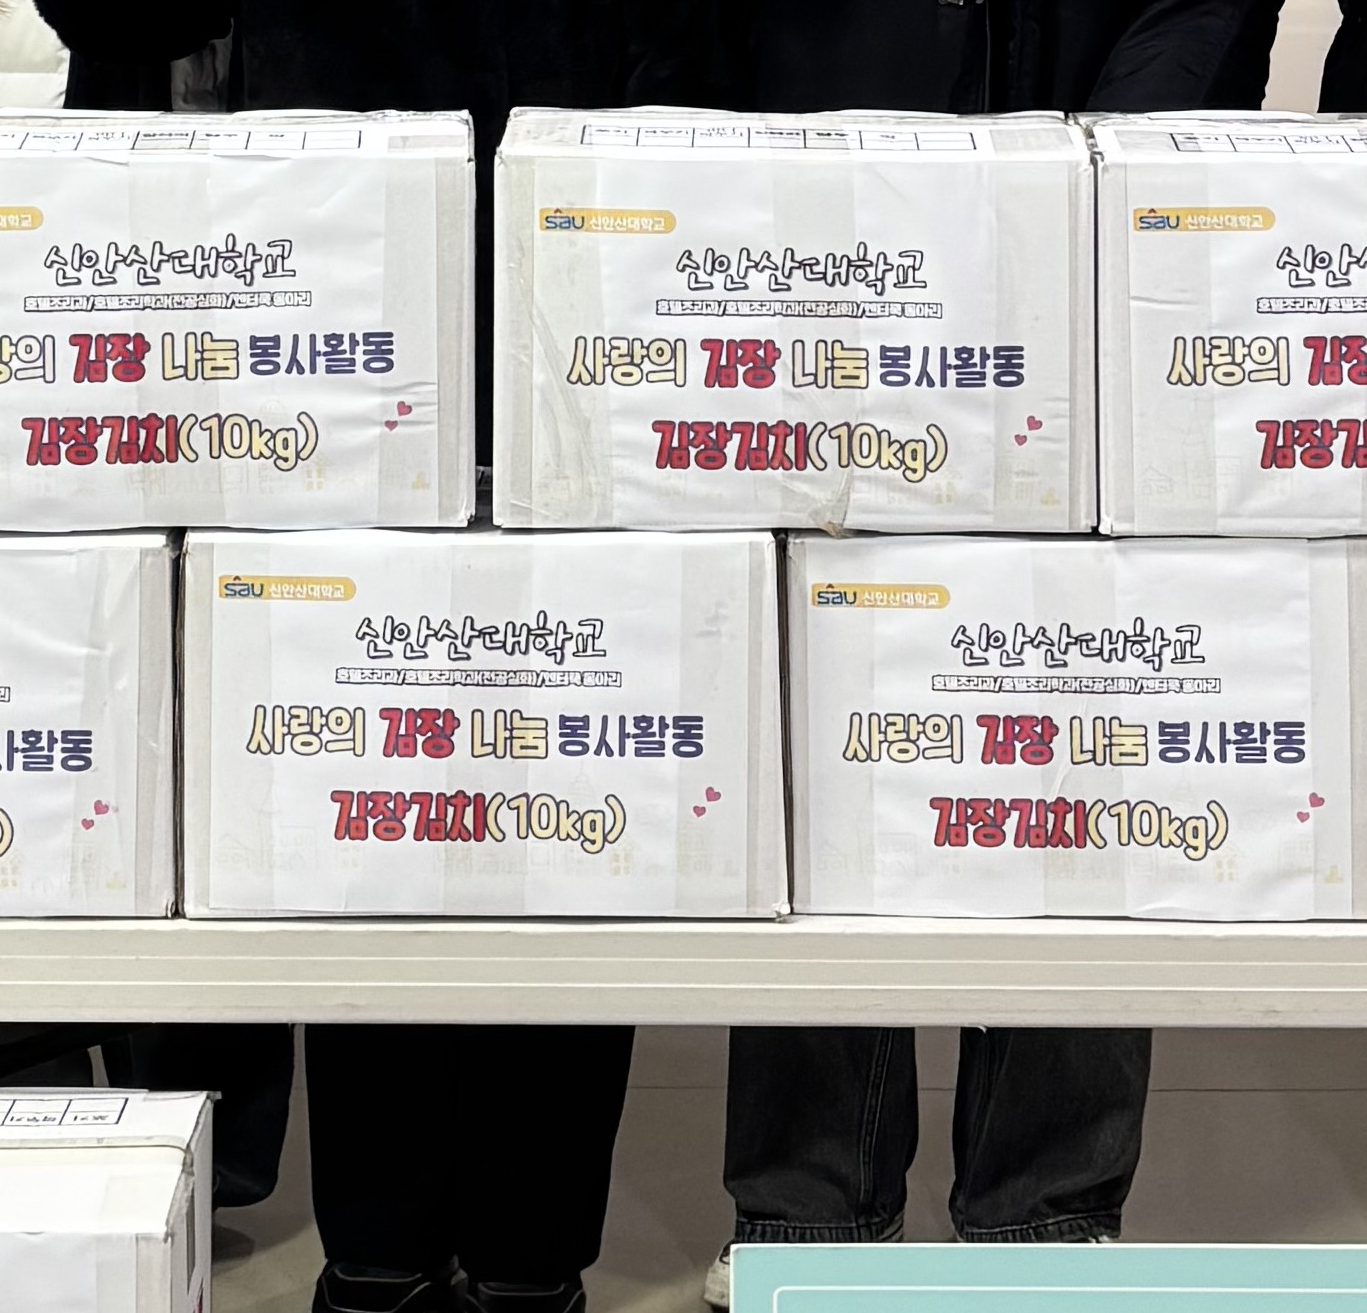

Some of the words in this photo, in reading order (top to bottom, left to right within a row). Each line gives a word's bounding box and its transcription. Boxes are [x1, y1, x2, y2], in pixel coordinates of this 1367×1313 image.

[22, 411, 319, 477] 김장김치(10kg)
[653, 418, 948, 485] 김장김치(10kg)
[331, 788, 627, 856] 김장김치(10kg)
[930, 795, 1229, 862] 김장김치(10kg)
